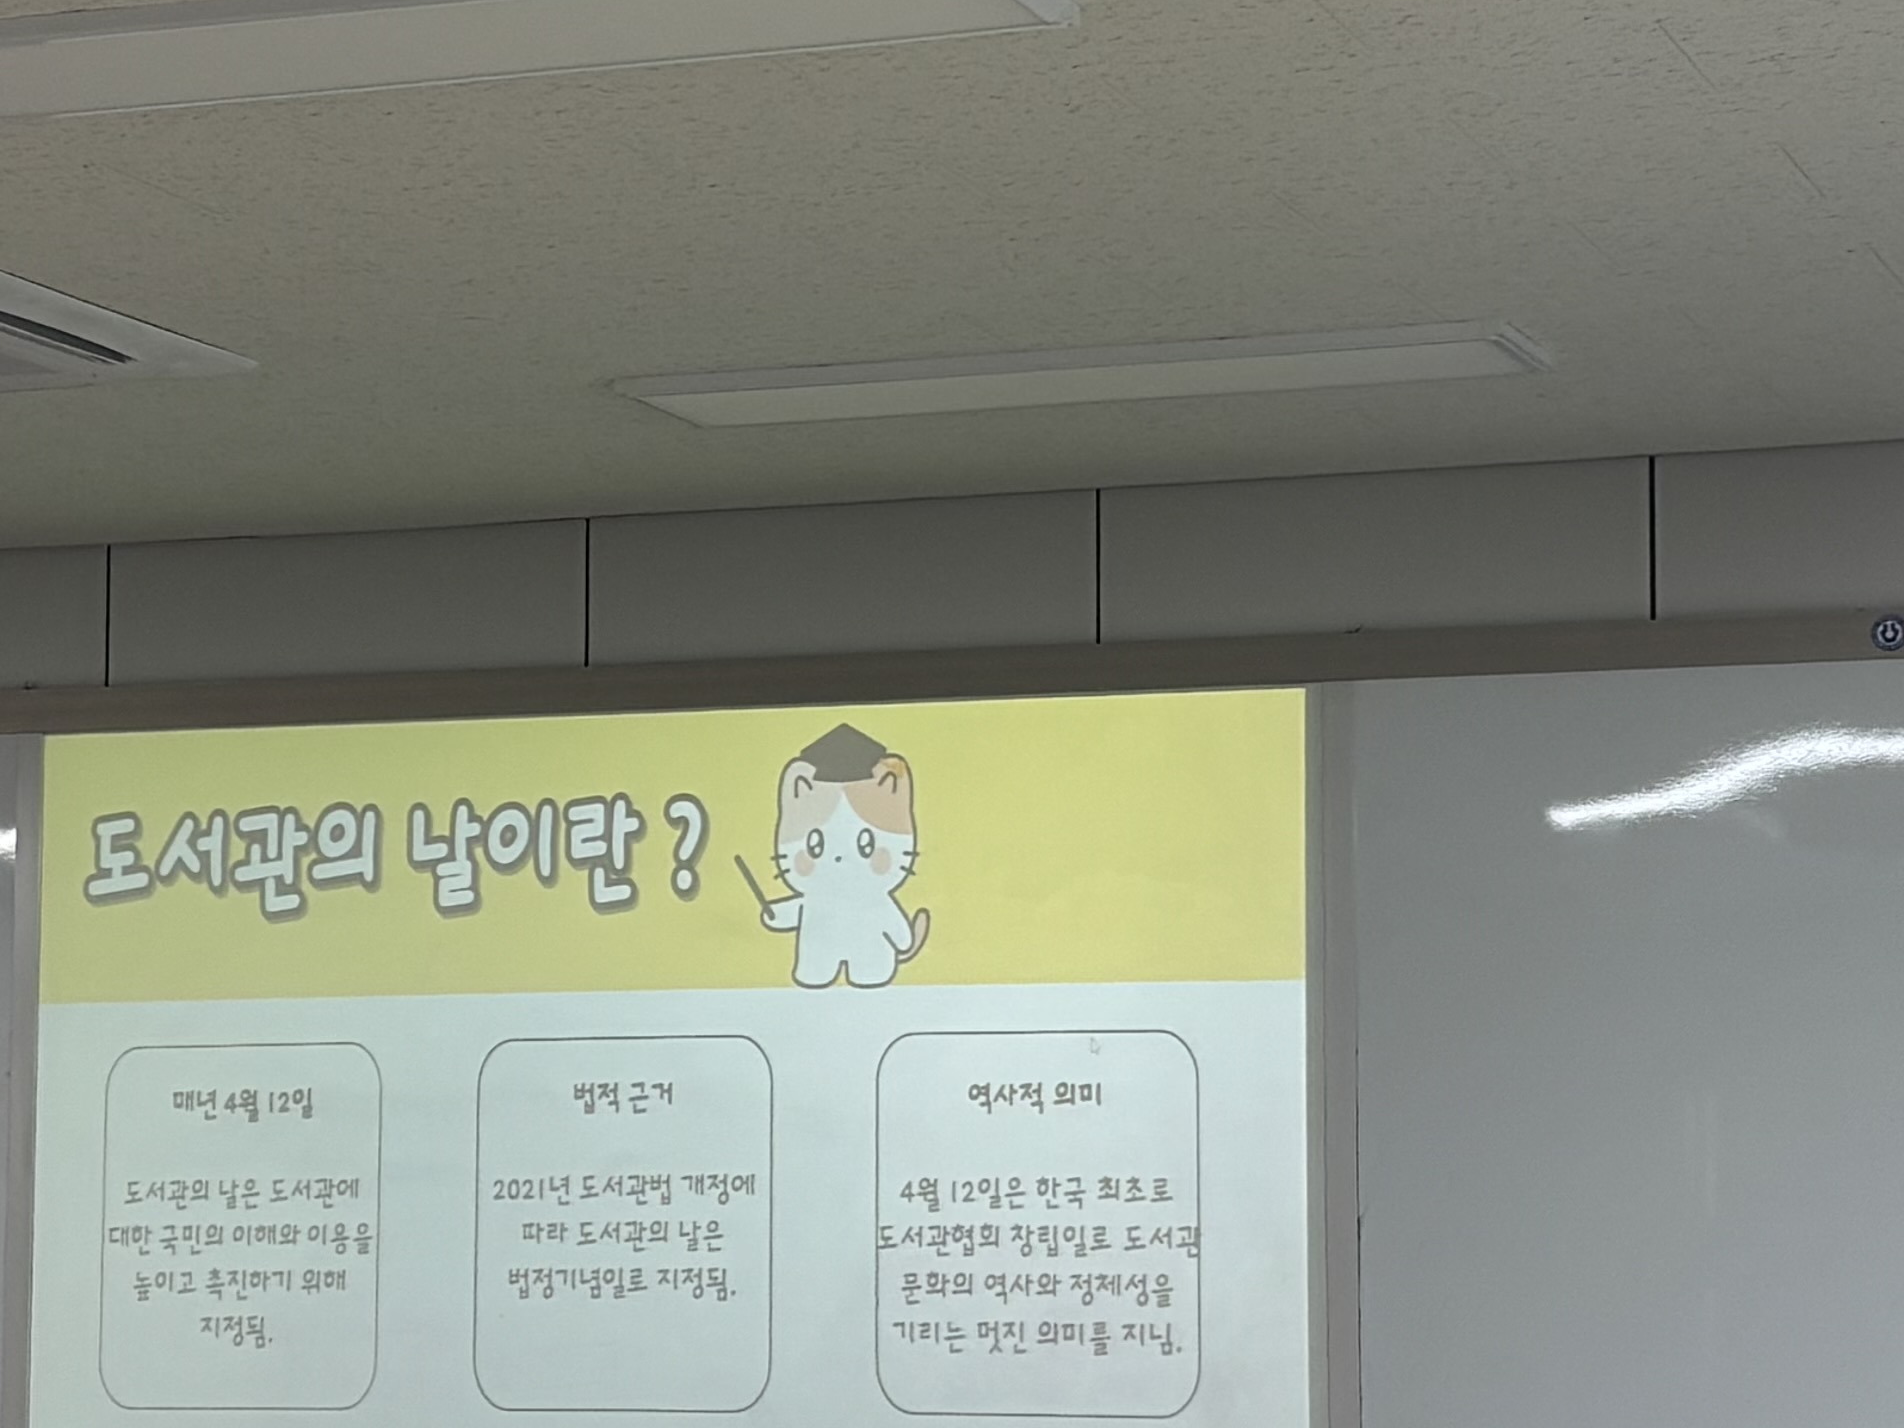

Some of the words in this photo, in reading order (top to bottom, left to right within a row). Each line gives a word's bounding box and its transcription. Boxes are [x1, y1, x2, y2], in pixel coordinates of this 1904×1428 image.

[81, 801, 387, 922] 도서관의
[406, 792, 647, 915] 날이란
[663, 792, 709, 899] ?
[172, 1089, 218, 1121] 매년
[223, 1088, 260, 1124] 4월
[268, 1087, 314, 1120] 12일
[573, 1081, 621, 1115] 법적
[627, 1081, 674, 1115] 근거
[967, 1081, 1045, 1115] 역사적
[1052, 1081, 1102, 1107] 의미
[123, 1179, 210, 1211] 도서관의
[218, 1178, 261, 1211] 날은
[269, 1177, 360, 1210] 도서관에
[492, 1175, 571, 1207] 2021년
[578, 1173, 672, 1207] 도서관법
[680, 1173, 756, 1206] 개정에
[899, 1176, 941, 1214] 4월
[951, 1176, 1027, 1211] 12일은
[1035, 1176, 1087, 1210] 한국
[1097, 1175, 1174, 1203] 최초로
[108, 1225, 153, 1257] 대한
[158, 1223, 224, 1256] 국민의
[232, 1223, 302, 1247] 이해와
[307, 1222, 374, 1256] 이용을
[521, 1221, 569, 1245] 따라
[575, 1220, 669, 1253] 도서관의
[678, 1219, 725, 1253] 날은
[878, 1222, 1001, 1258] 도서관협회
[1009, 1223, 1113, 1258] 창립일로
[1123, 1225, 1201, 1259] 도서관
[132, 1271, 197, 1302] 높이고
[205, 1267, 292, 1301] 촉진하기
[300, 1268, 347, 1296] 위해
[508, 1267, 649, 1300] 법정기념일로
[656, 1266, 737, 1302] 지정됨.
[900, 1270, 974, 1306] 문화의
[983, 1272, 1063, 1306] 역사와
[1069, 1273, 1174, 1309] 정체성을
[199, 1315, 273, 1350] 지정됨.
[892, 1321, 967, 1354] 기리는
[976, 1320, 1028, 1355] 멋진
[1036, 1320, 1112, 1357] 의미를
[1121, 1322, 1183, 1357] 지님.
